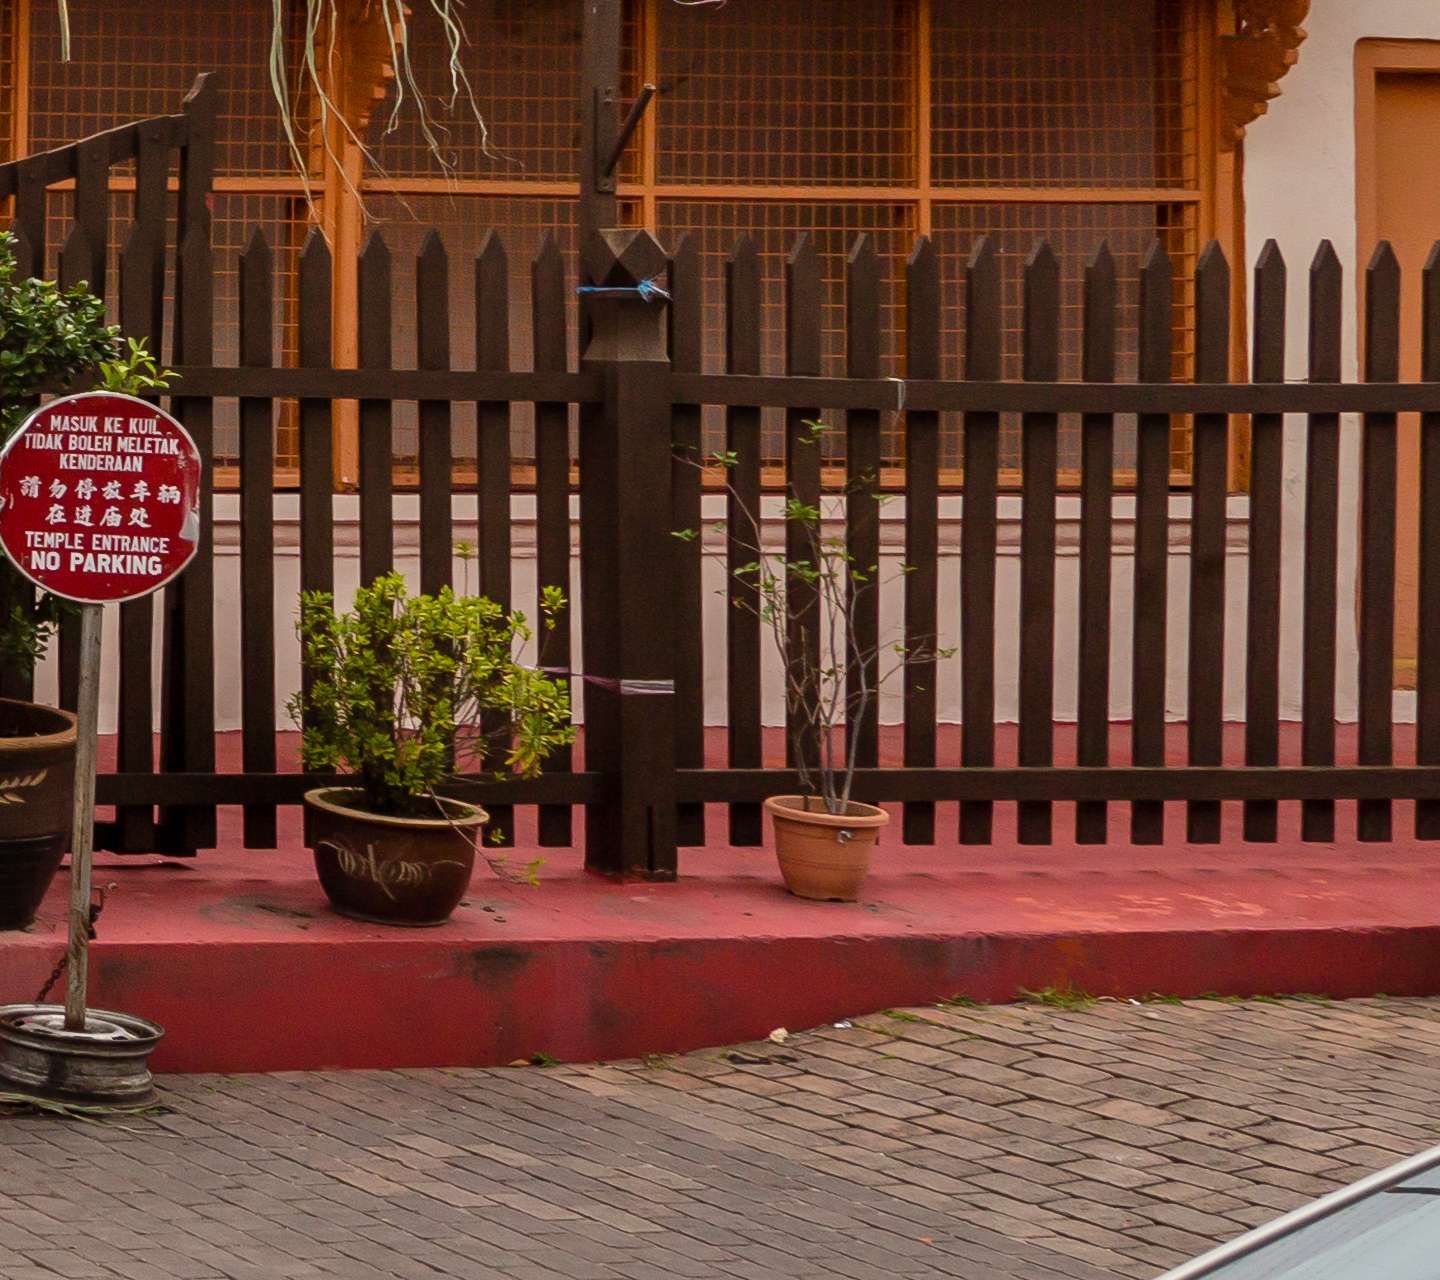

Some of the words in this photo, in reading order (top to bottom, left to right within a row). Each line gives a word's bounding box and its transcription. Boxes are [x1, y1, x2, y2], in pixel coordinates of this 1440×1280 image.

[50, 415, 98, 432] MASUK
[104, 417, 123, 434] KE
[129, 418, 161, 435] KUIL
[25, 433, 63, 450] TIDAK
[68, 435, 112, 452] BOLEH
[117, 437, 180, 455] MELETAK
[59, 453, 143, 472] KENDERAAN
[25, 531, 85, 550] TEMPLE
[92, 534, 170, 554] ENTRANCE
[31, 551, 61, 571] NO
[69, 553, 162, 576] PARKING
